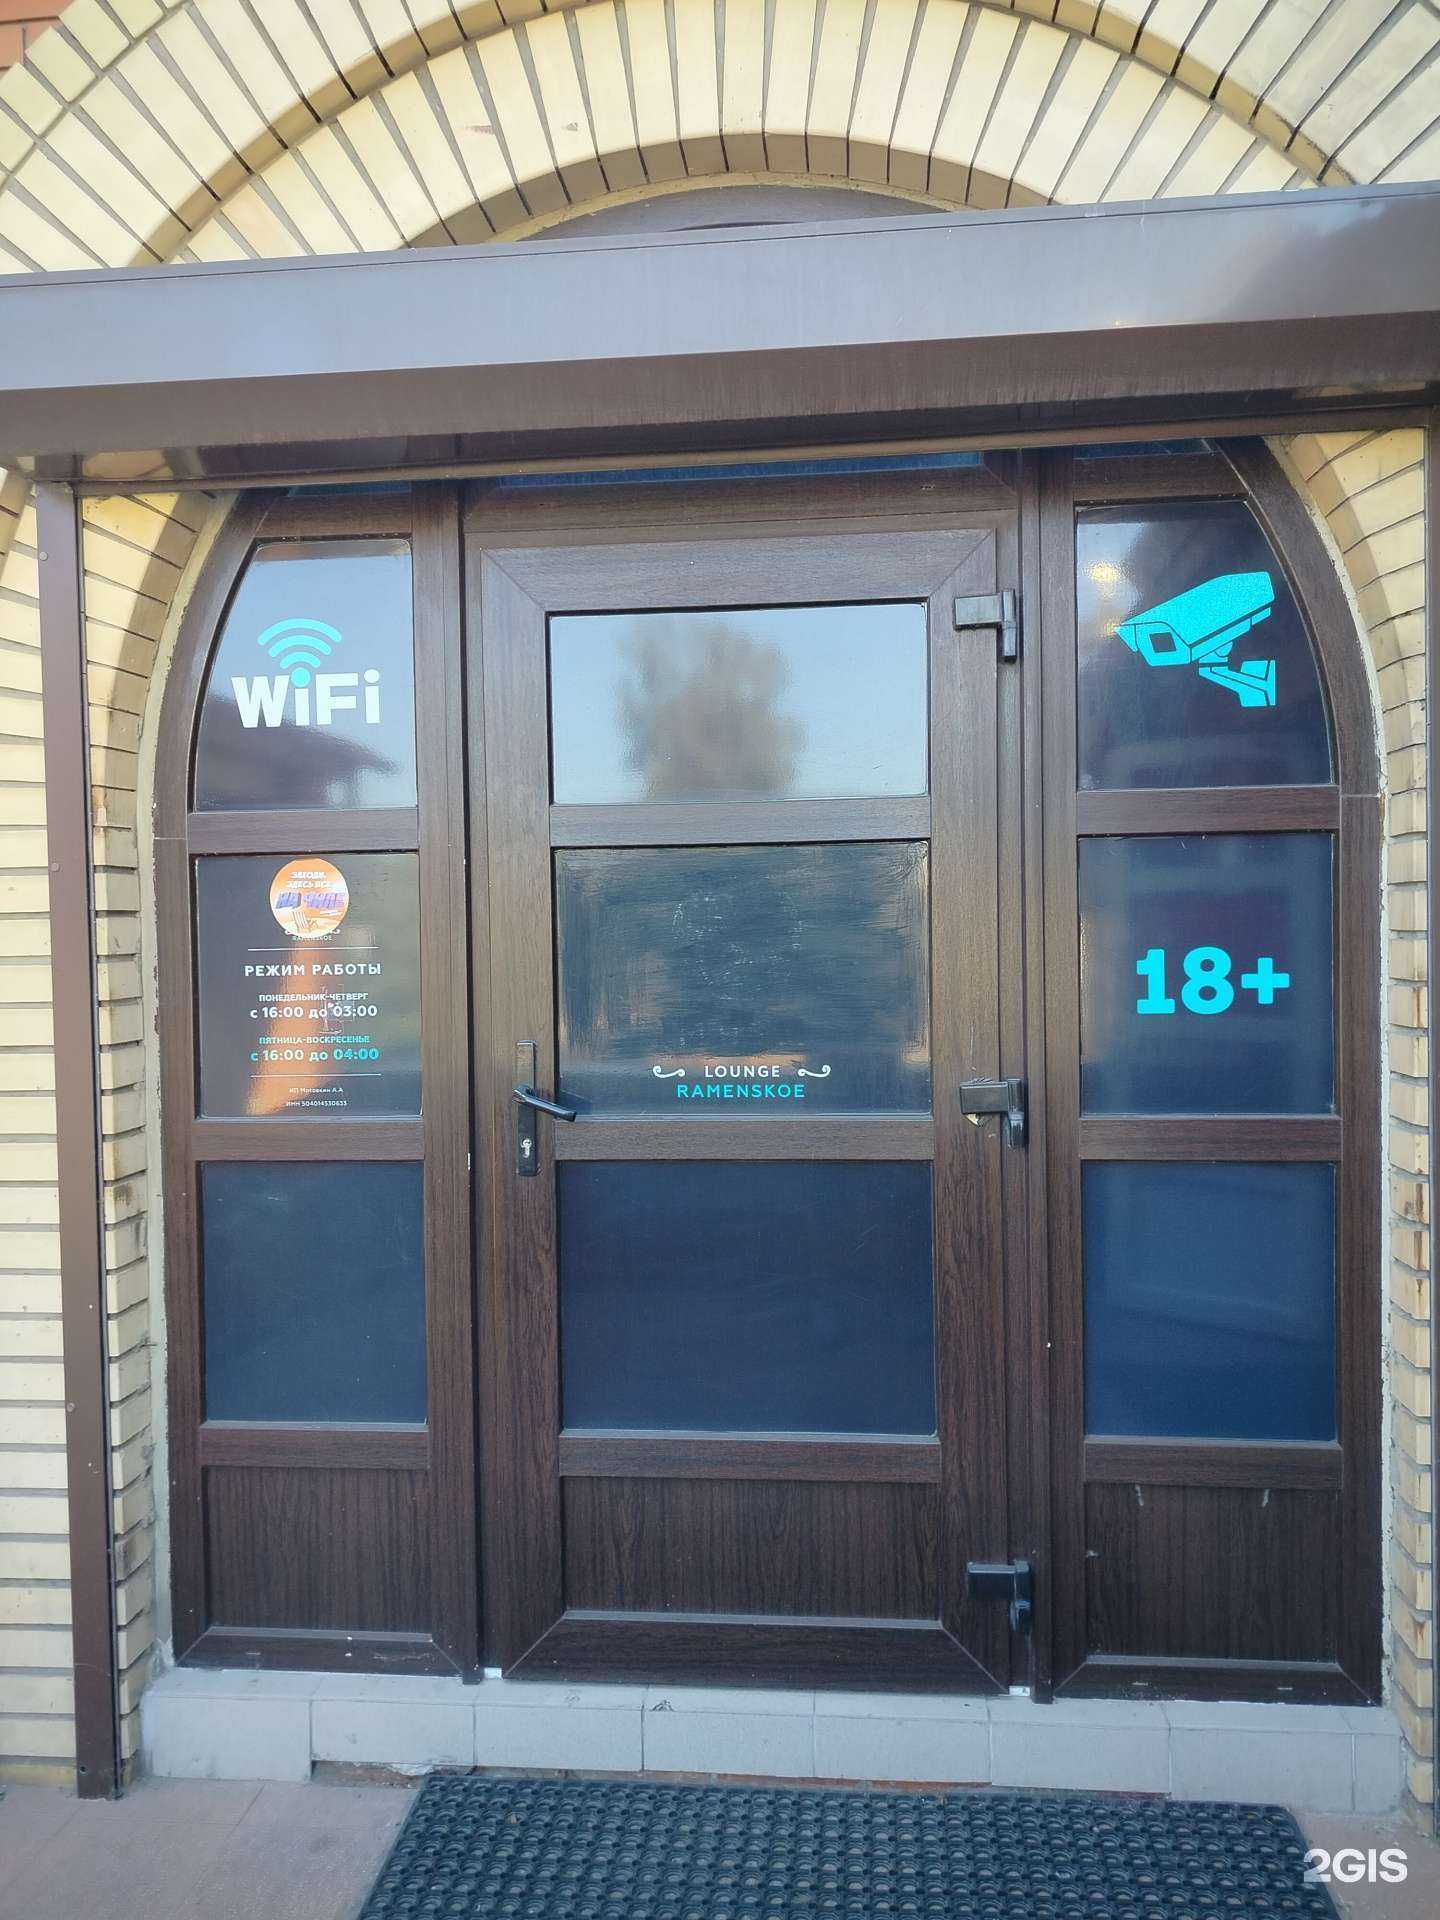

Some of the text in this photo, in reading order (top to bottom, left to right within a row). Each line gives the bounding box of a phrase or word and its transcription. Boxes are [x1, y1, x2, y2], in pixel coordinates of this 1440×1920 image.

[231, 667, 381, 728] WiFi
[245, 963, 381, 977] РЕЖИМ РАБОТЫ
[1136, 946, 1290, 1015] 18+
[258, 992, 369, 1002] ПОНЕДЕЛЬНИК-ЧЕТВЕРГ
[262, 1006, 304, 1018] 16:00
[309, 1007, 328, 1019] до
[333, 1005, 378, 1017] 03:00
[259, 1035, 370, 1045] ПЯТНИЦА-ВОСКРЕСЕНЬЕ
[263, 1049, 304, 1061] 16:00
[309, 1050, 328, 1062] до
[333, 1048, 379, 1060] 04:00
[704, 1065, 782, 1079] LOUNGE
[677, 1084, 805, 1098] RAMENSKOE
